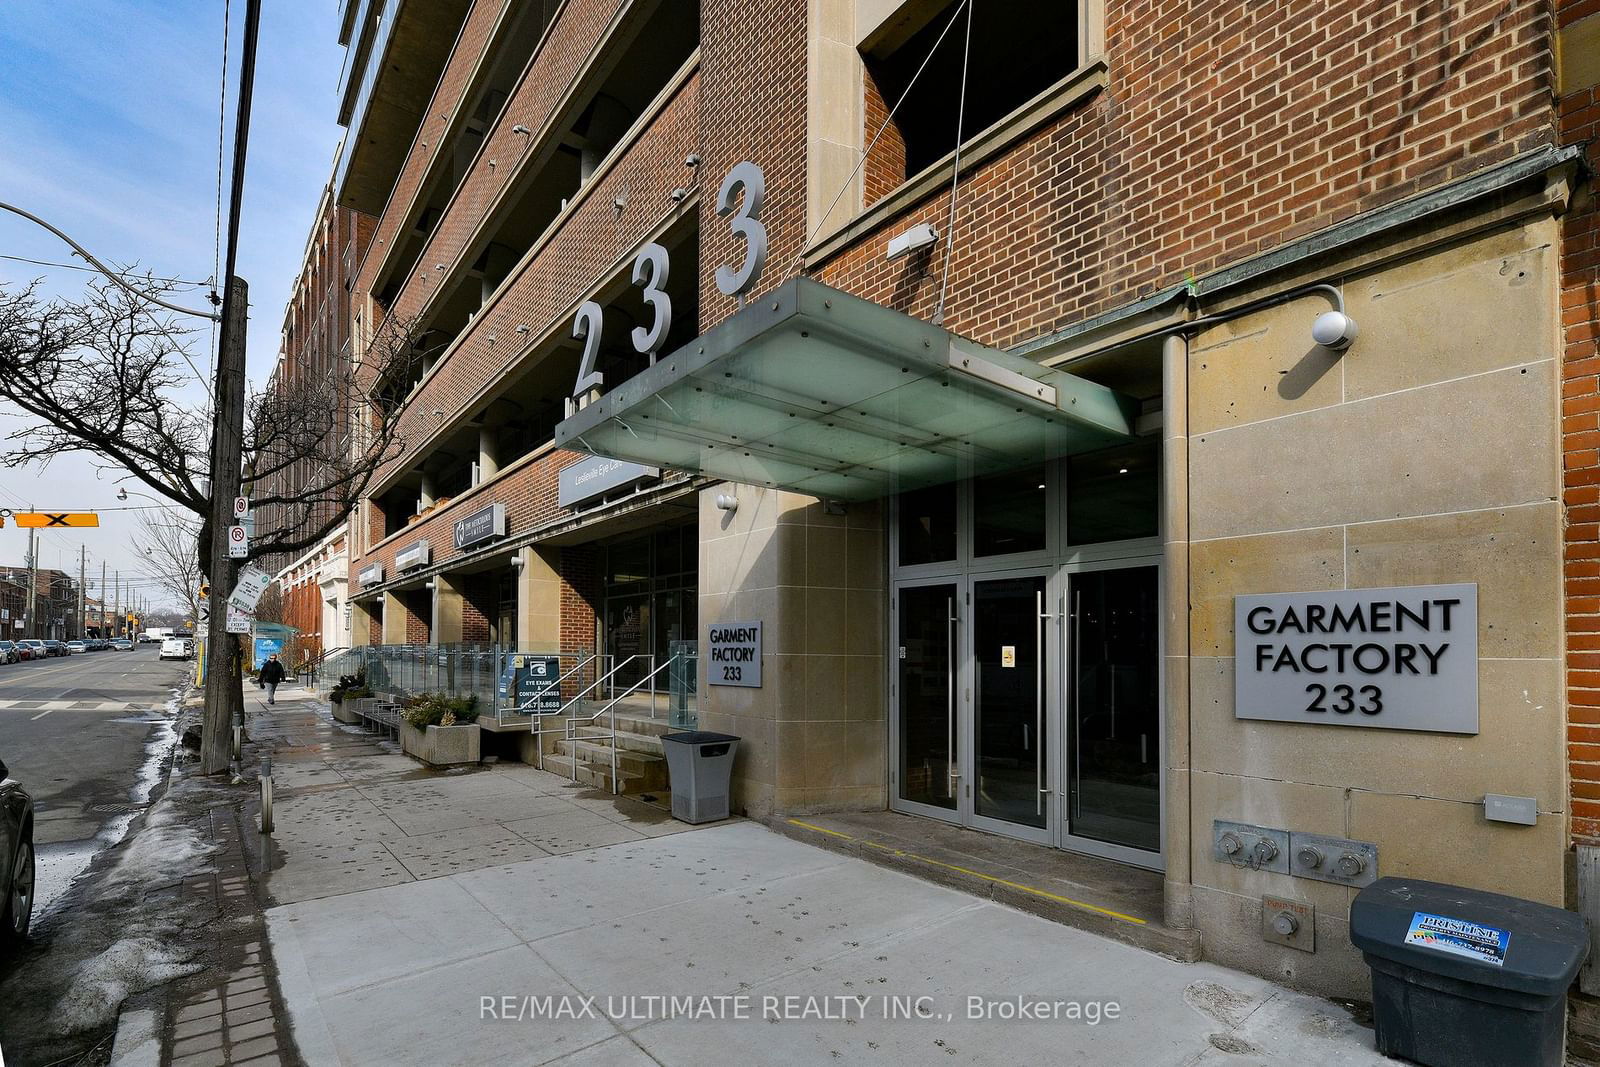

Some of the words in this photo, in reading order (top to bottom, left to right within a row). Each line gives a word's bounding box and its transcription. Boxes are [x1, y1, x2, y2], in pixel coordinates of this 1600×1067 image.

[598, 462, 610, 477] Eye
[1247, 599, 1461, 635] GARMENT
[710, 627, 758, 643] GARMENT
[712, 647, 755, 662] FACTORY
[1256, 643, 1450, 675] FACTORY
[723, 665, 742, 681] 233
[1305, 683, 1383, 716] 233
[1420, 924, 1451, 936] PROPERTY
[1452, 930, 1499, 945] MAINTENANCE
[1424, 916, 1500, 940] PRISTINE
